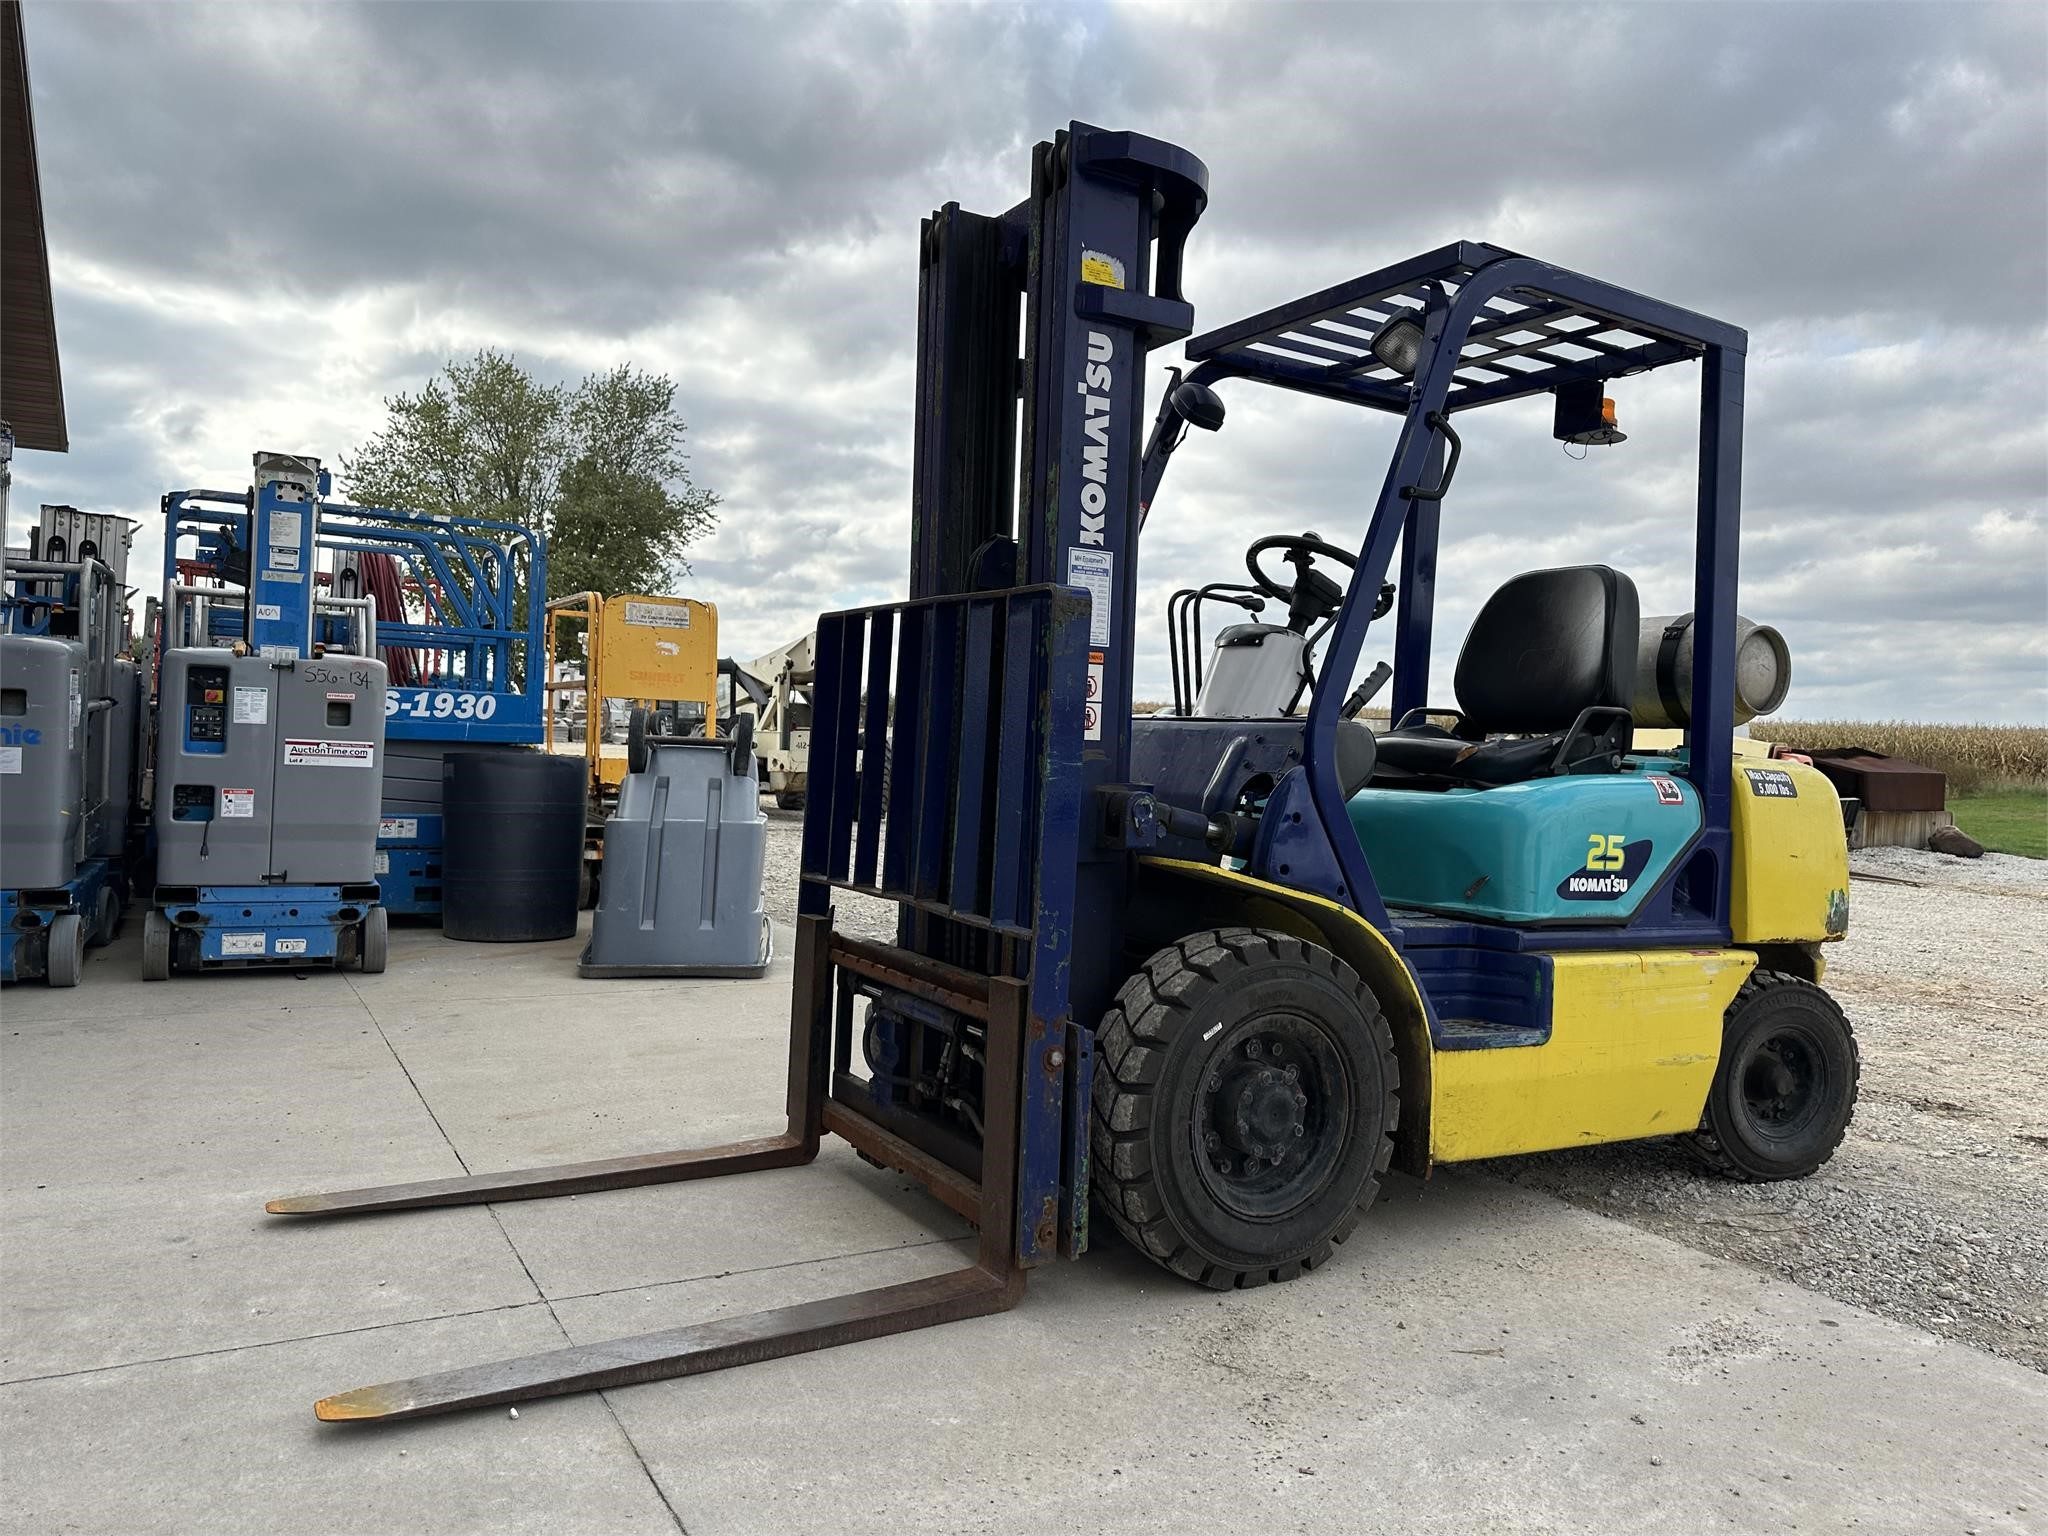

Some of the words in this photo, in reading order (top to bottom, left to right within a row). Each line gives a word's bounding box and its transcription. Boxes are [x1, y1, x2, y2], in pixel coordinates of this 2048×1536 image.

[1077, 331, 1114, 546] KOMATSU
[384, 690, 497, 720] S-1930
[290, 746, 368, 756] AuctionTime.com
[1746, 770, 1764, 780] Max
[1762, 770, 1792, 784] Capacity
[1758, 783, 1778, 795] 5,000
[1587, 834, 1626, 871] 25
[1569, 875, 1628, 893] KOMATSU
